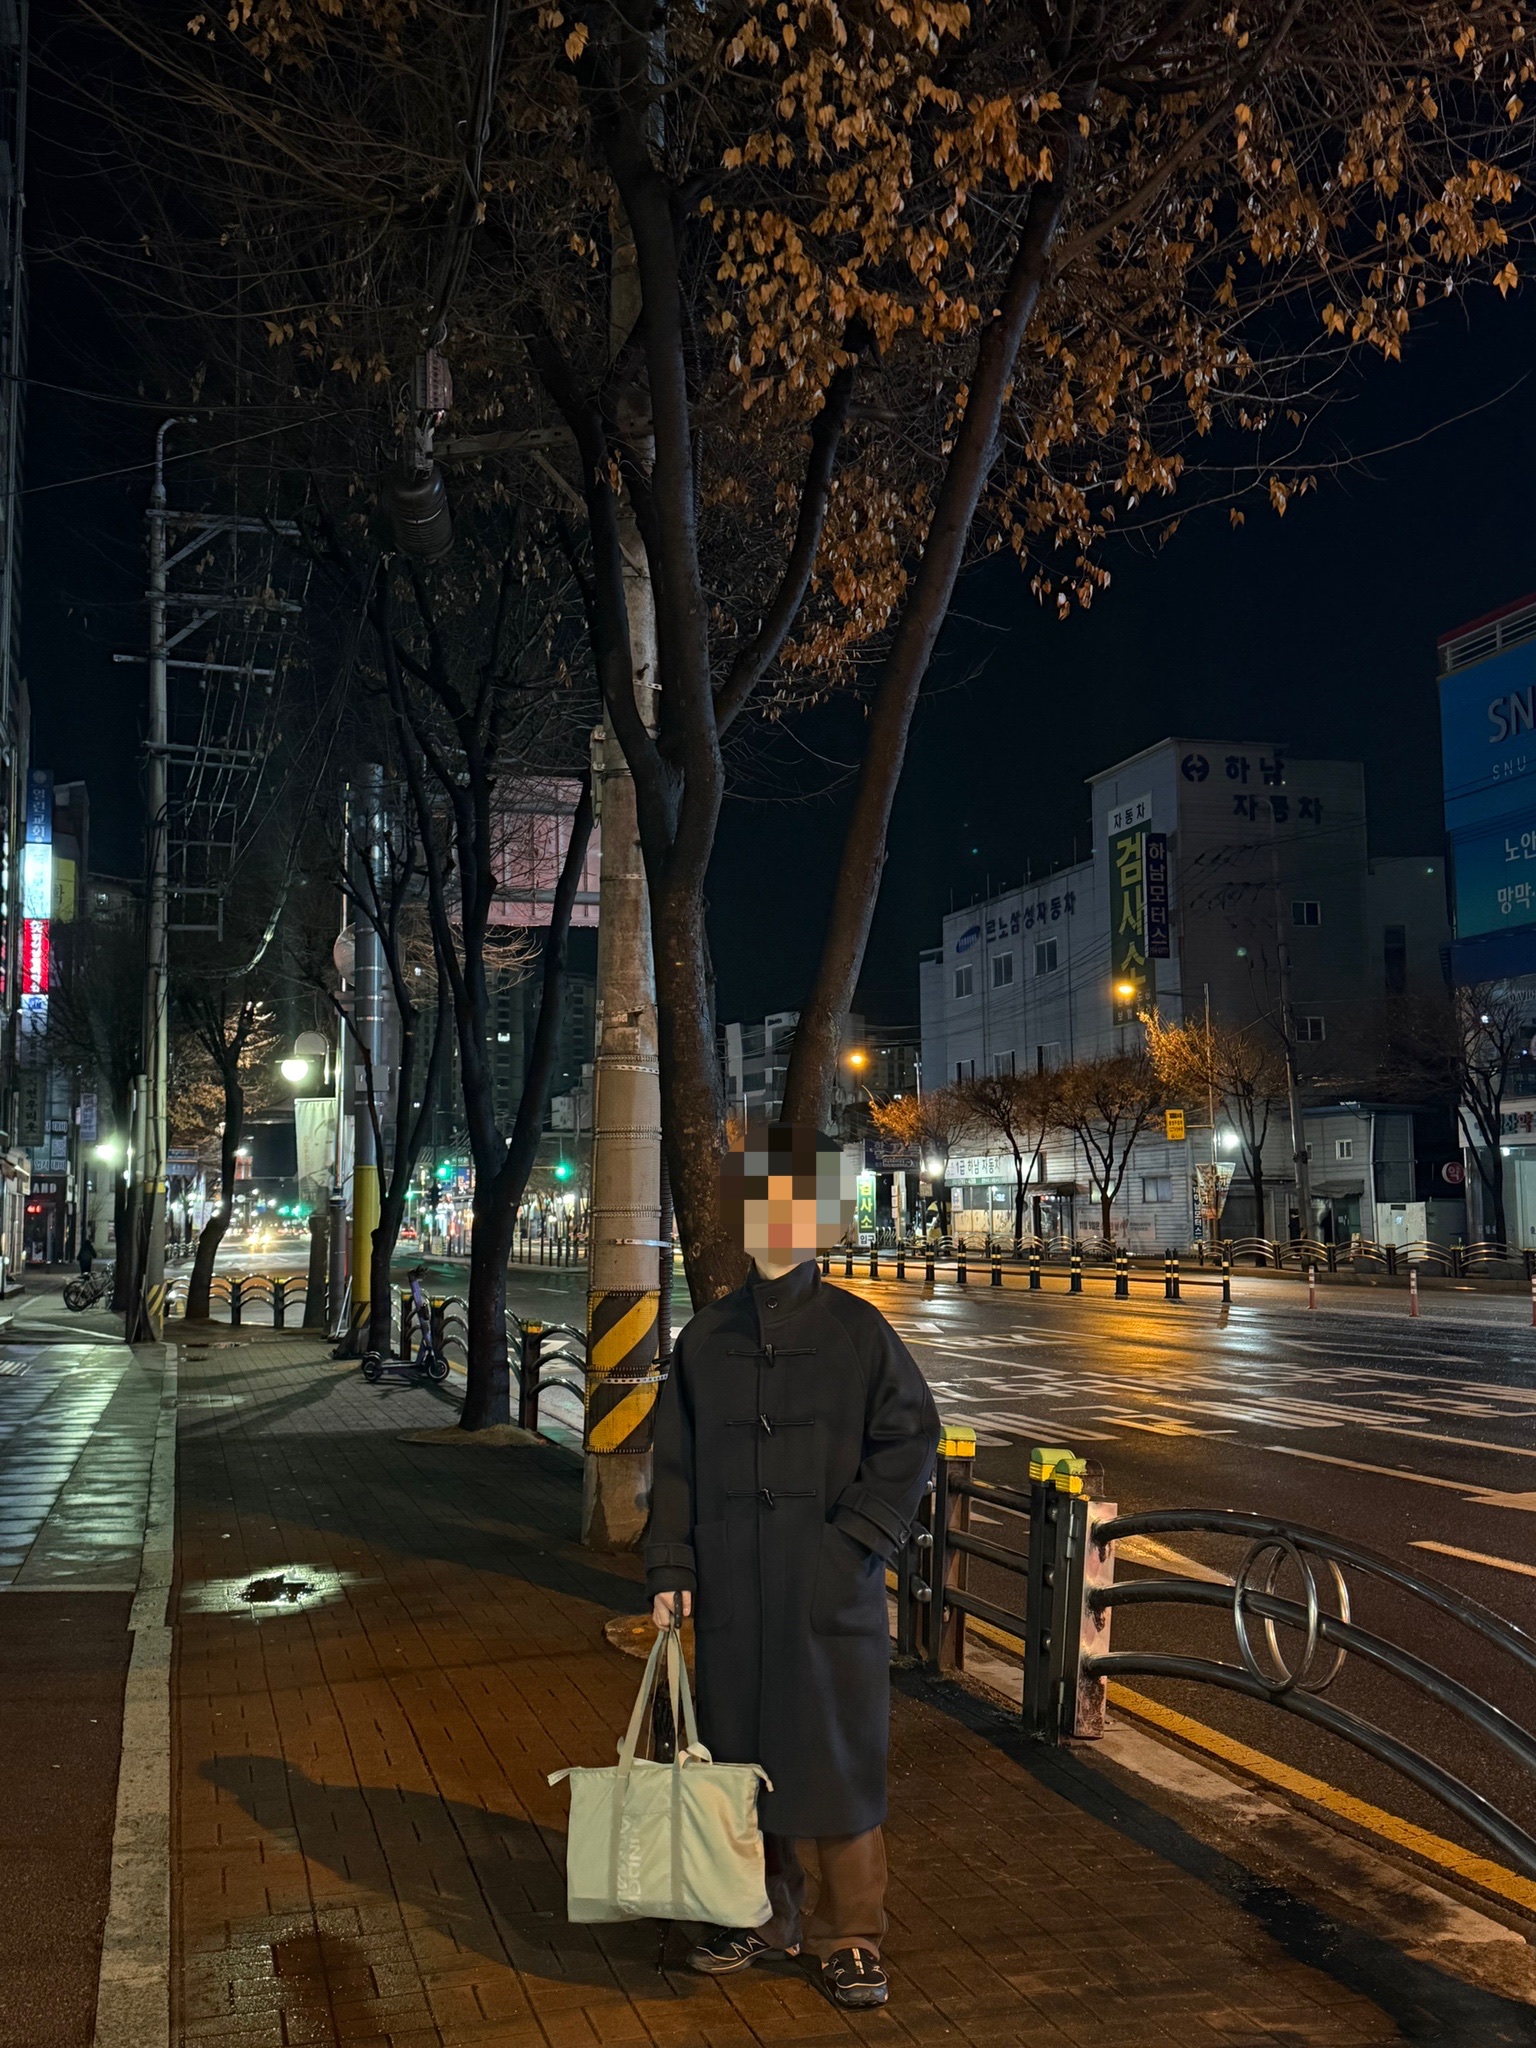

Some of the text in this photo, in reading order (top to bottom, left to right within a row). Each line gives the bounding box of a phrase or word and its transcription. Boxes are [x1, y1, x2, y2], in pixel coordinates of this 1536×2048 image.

[1225, 756, 1285, 786] 하남
[1492, 755, 1527, 781] SNU
[1113, 801, 1146, 830] 자동차
[1233, 794, 1324, 825] 자동차
[1148, 841, 1168, 946] 하남모터스
[985, 890, 1076, 943] 르노삼성자동차
[1115, 831, 1148, 988] 검사소
[967, 1158, 980, 1175] 하남
[982, 1157, 1001, 1174] 자동차
[1448, 1165, 1462, 1182] 약
[859, 1234, 875, 1246] 입구
